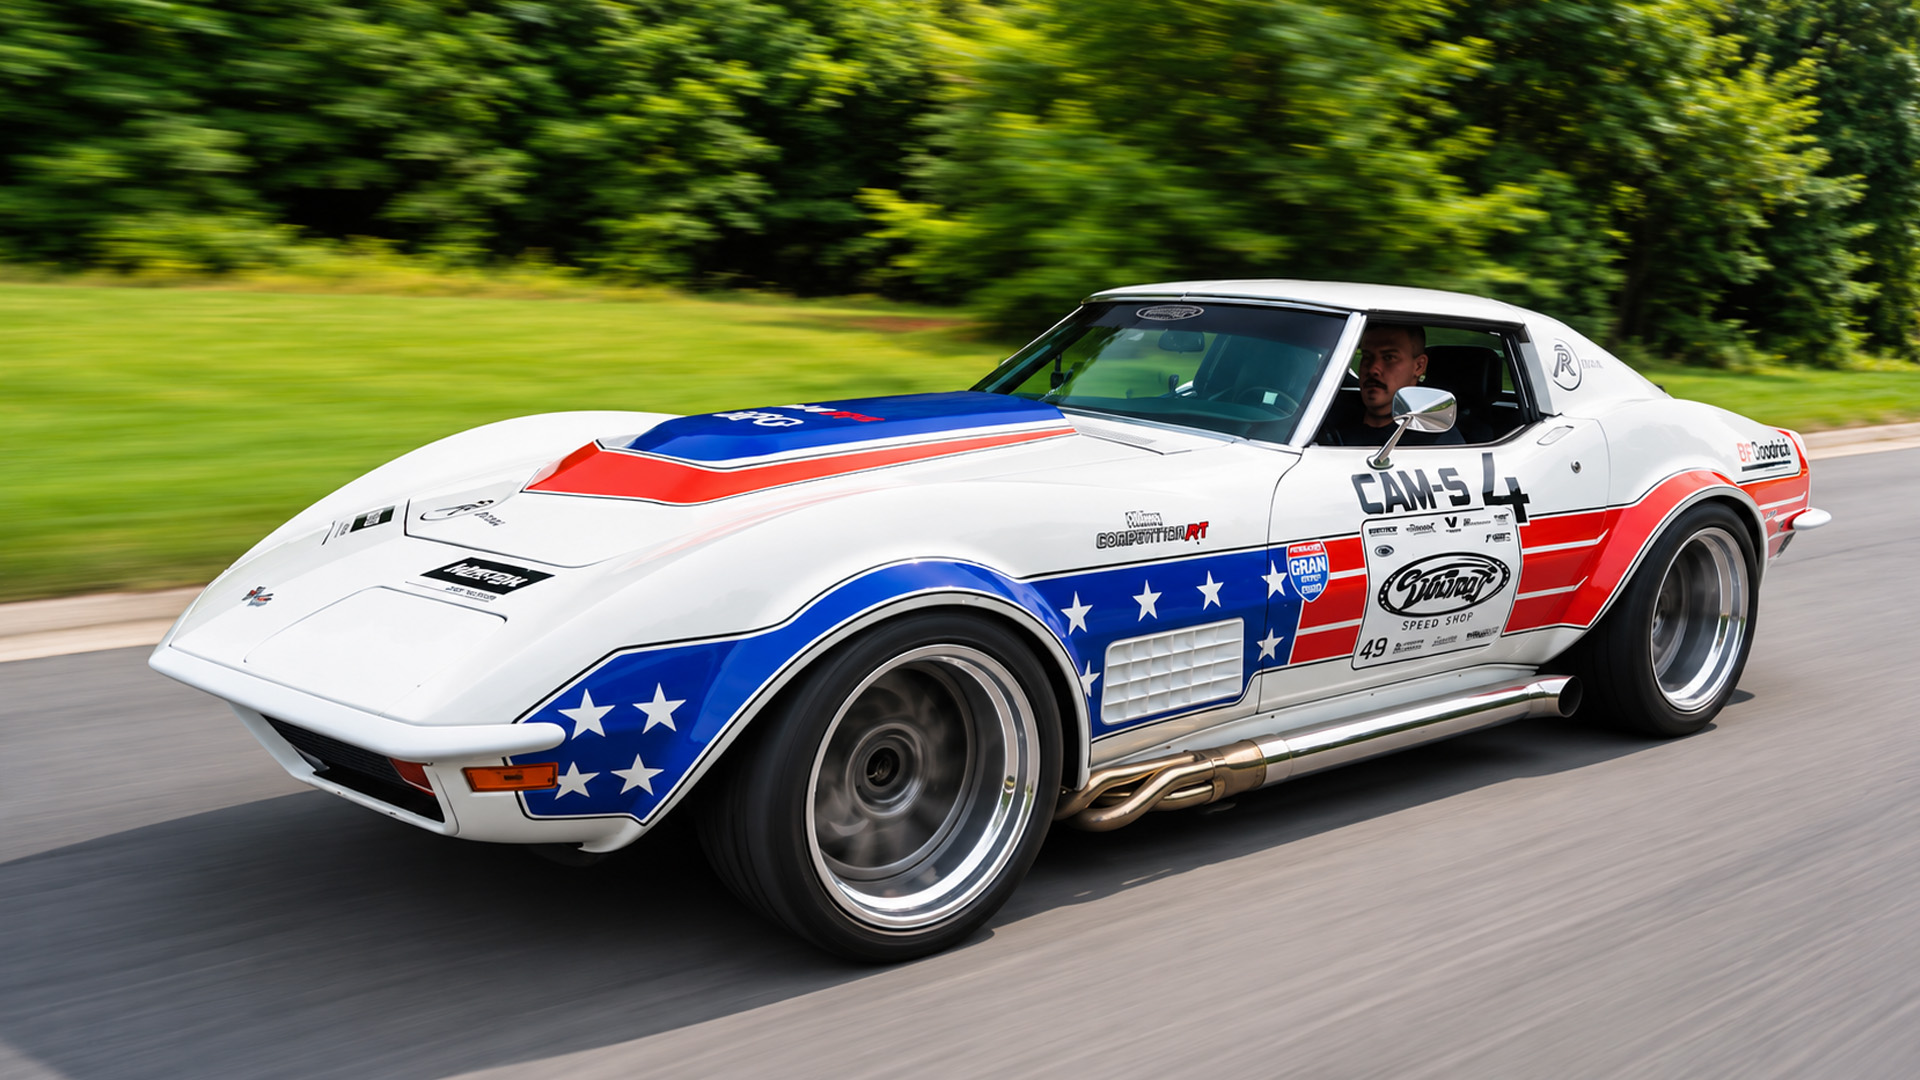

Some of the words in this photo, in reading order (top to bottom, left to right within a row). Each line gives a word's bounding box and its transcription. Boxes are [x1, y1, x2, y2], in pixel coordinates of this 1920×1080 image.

[1351, 468, 1471, 515] CAM-S
[1482, 452, 1530, 524] 4
[1291, 556, 1327, 576] GRAN
[1402, 618, 1439, 631] SPEED
[1445, 612, 1474, 626] SHOP
[1359, 637, 1388, 660] 49
